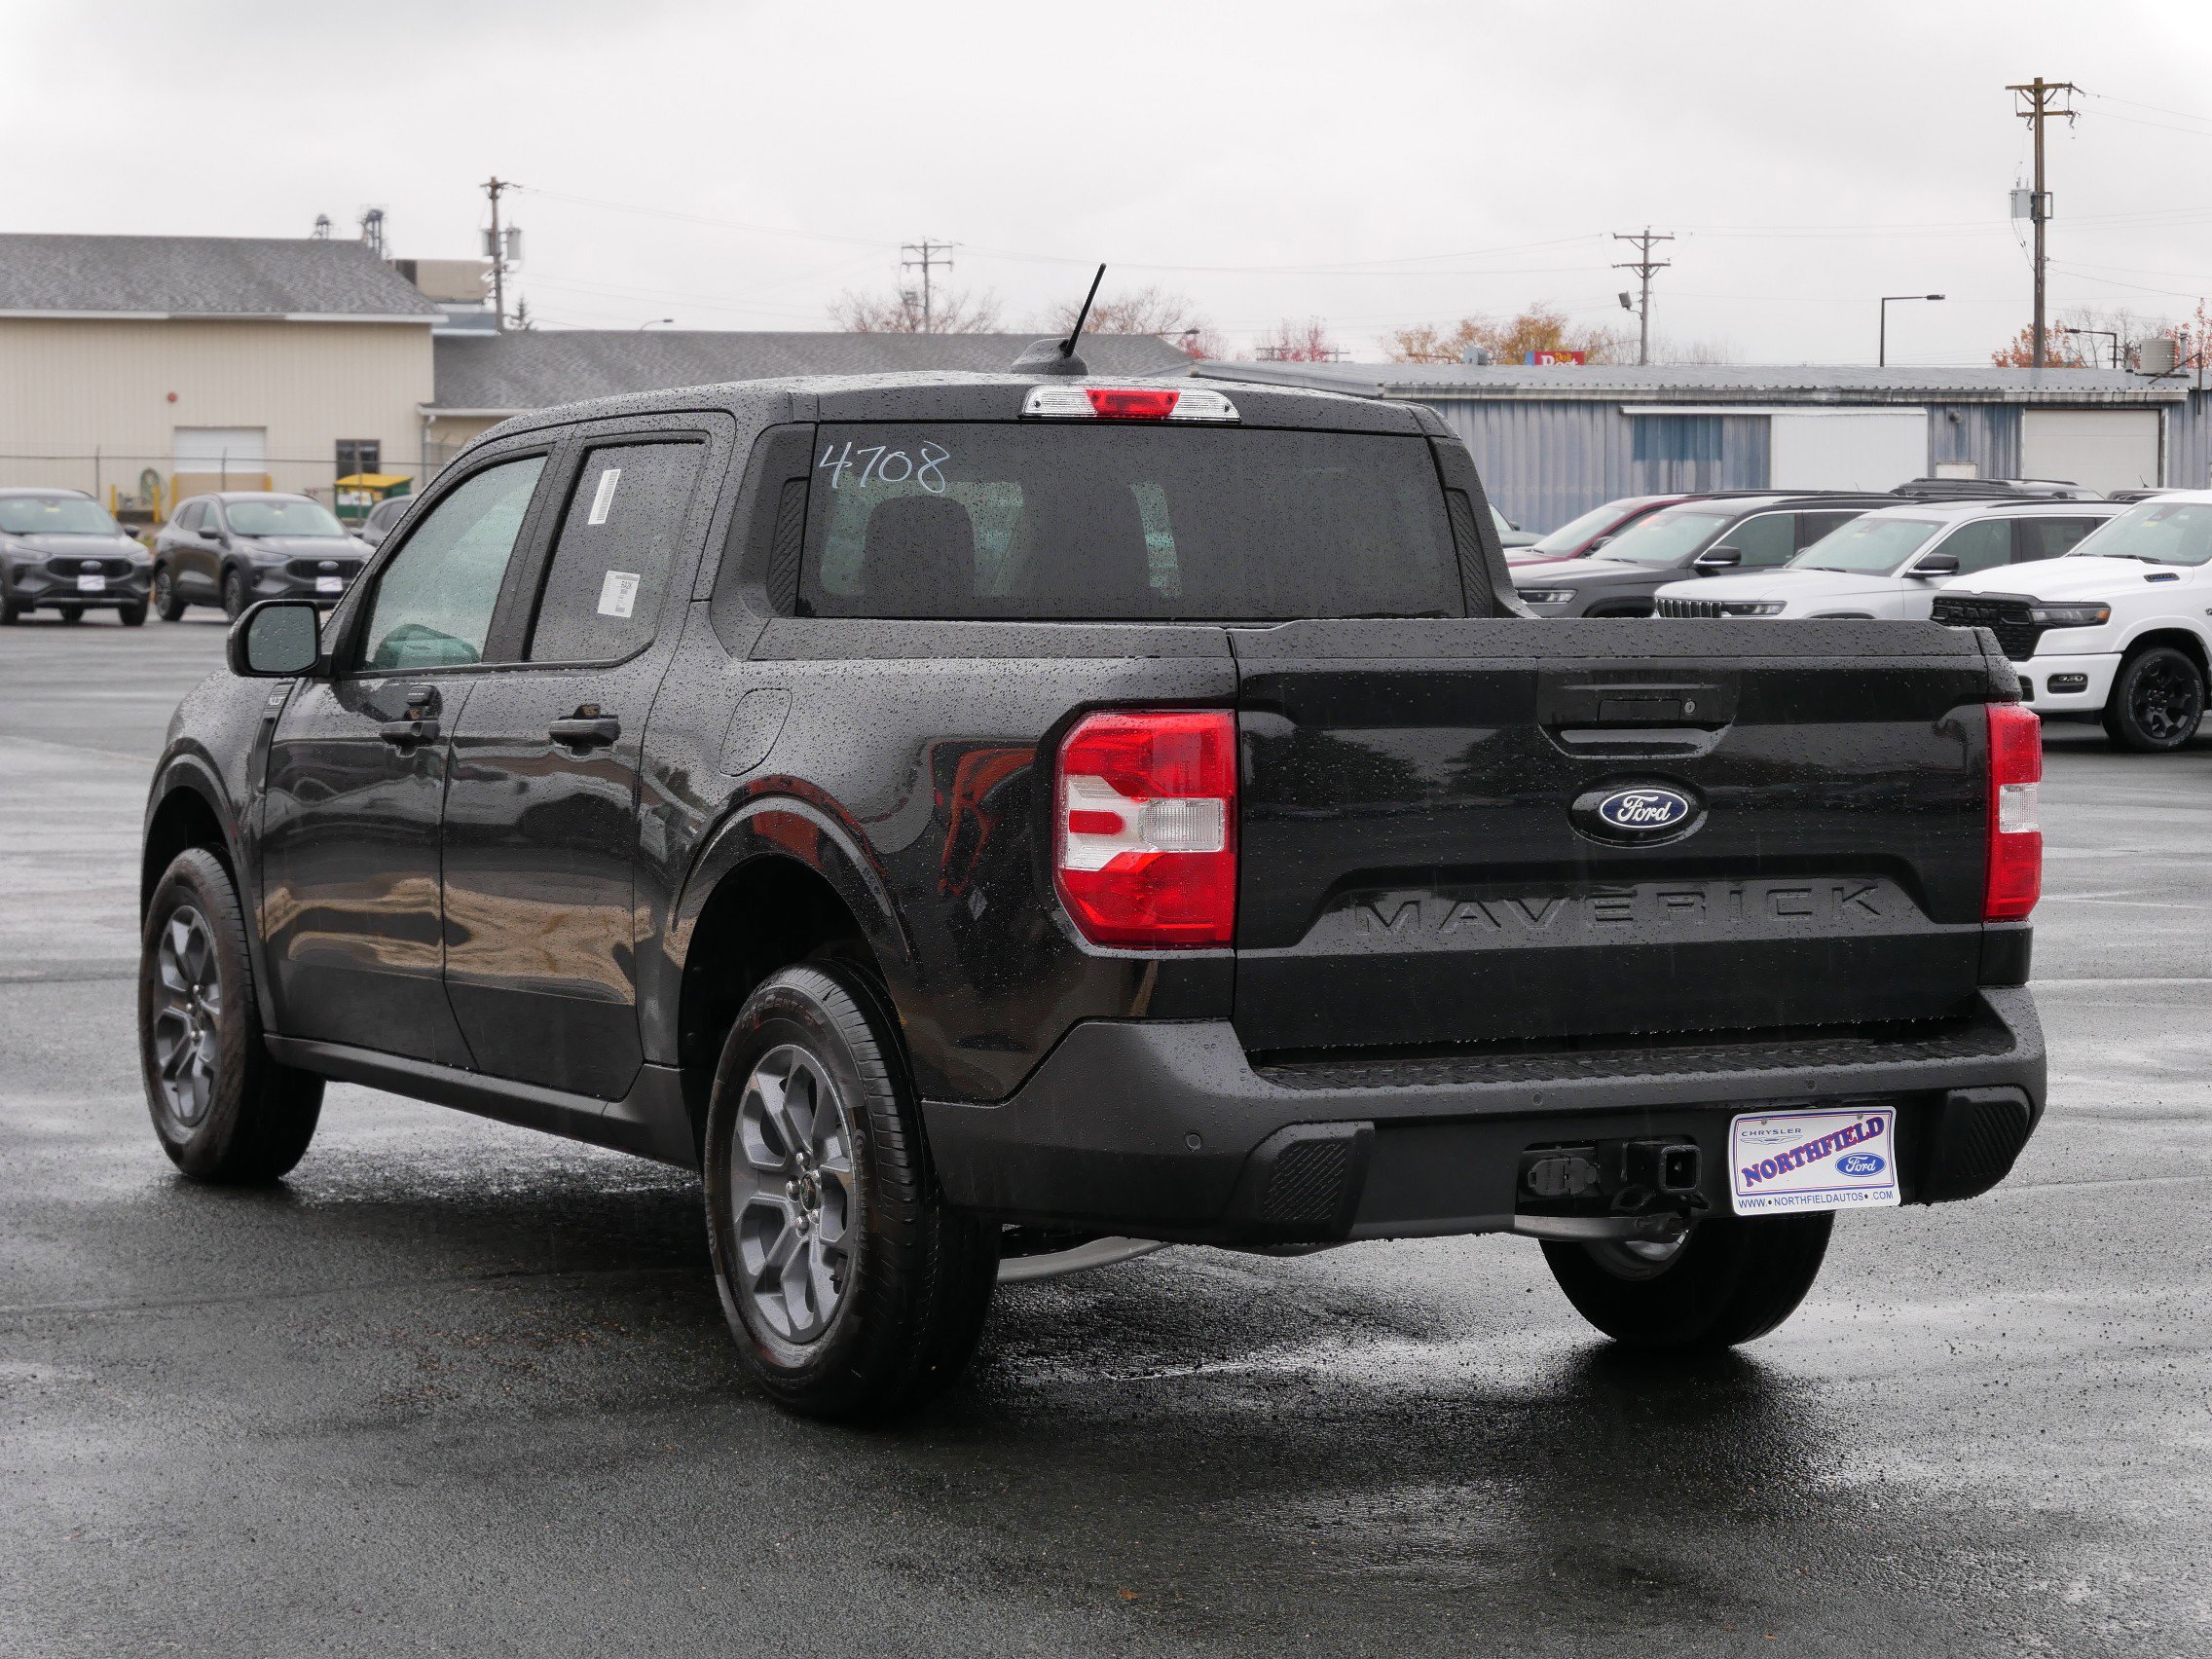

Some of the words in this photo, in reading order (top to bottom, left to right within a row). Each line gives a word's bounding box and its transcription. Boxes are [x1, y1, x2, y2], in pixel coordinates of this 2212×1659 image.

[819, 440, 950, 494] 4708
[1617, 794, 1673, 822] Ford
[1354, 885, 1881, 936] MAVERICK
[1741, 1127, 1802, 1137] CHRYSLER
[1741, 1116, 1885, 1188] NORTHFIELD
[1845, 1156, 1877, 1173] Ford
